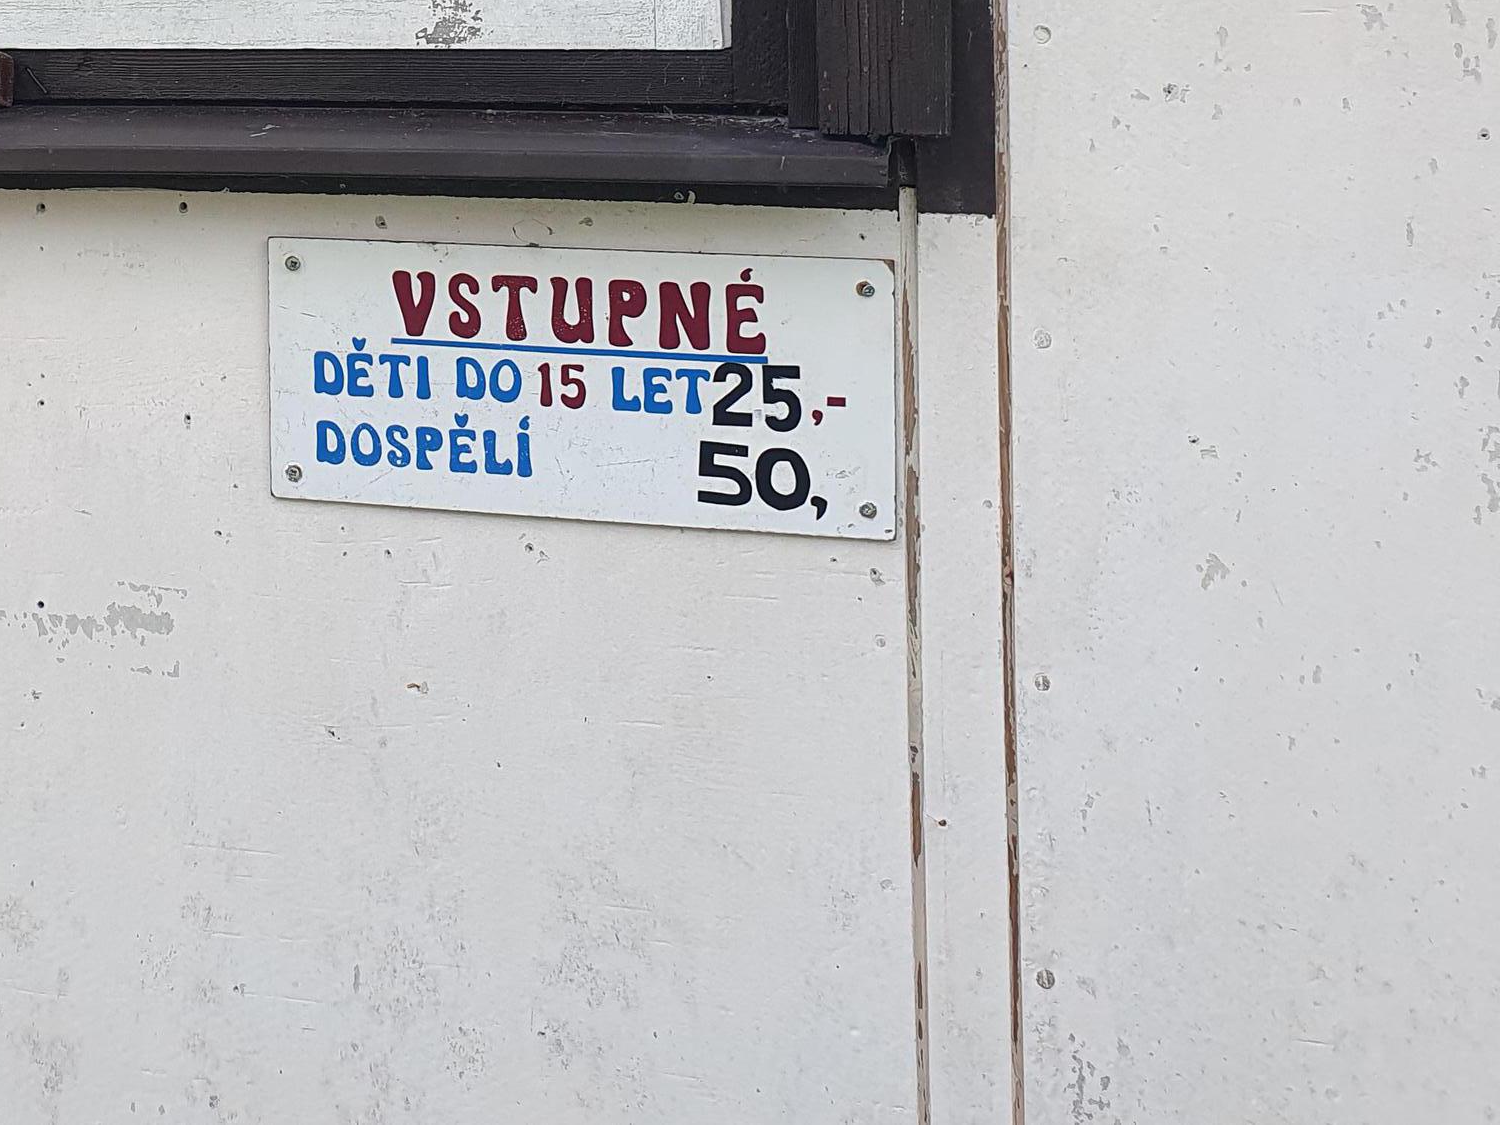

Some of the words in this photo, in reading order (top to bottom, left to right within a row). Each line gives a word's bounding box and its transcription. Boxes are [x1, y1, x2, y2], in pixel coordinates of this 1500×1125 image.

[392, 267, 768, 355] VSTUPNÉ
[312, 336, 432, 401] DĚTI
[455, 355, 523, 404] DO
[538, 361, 587, 410] 15
[611, 365, 712, 416] LET
[315, 412, 533, 478] DOSPĚLÍ
